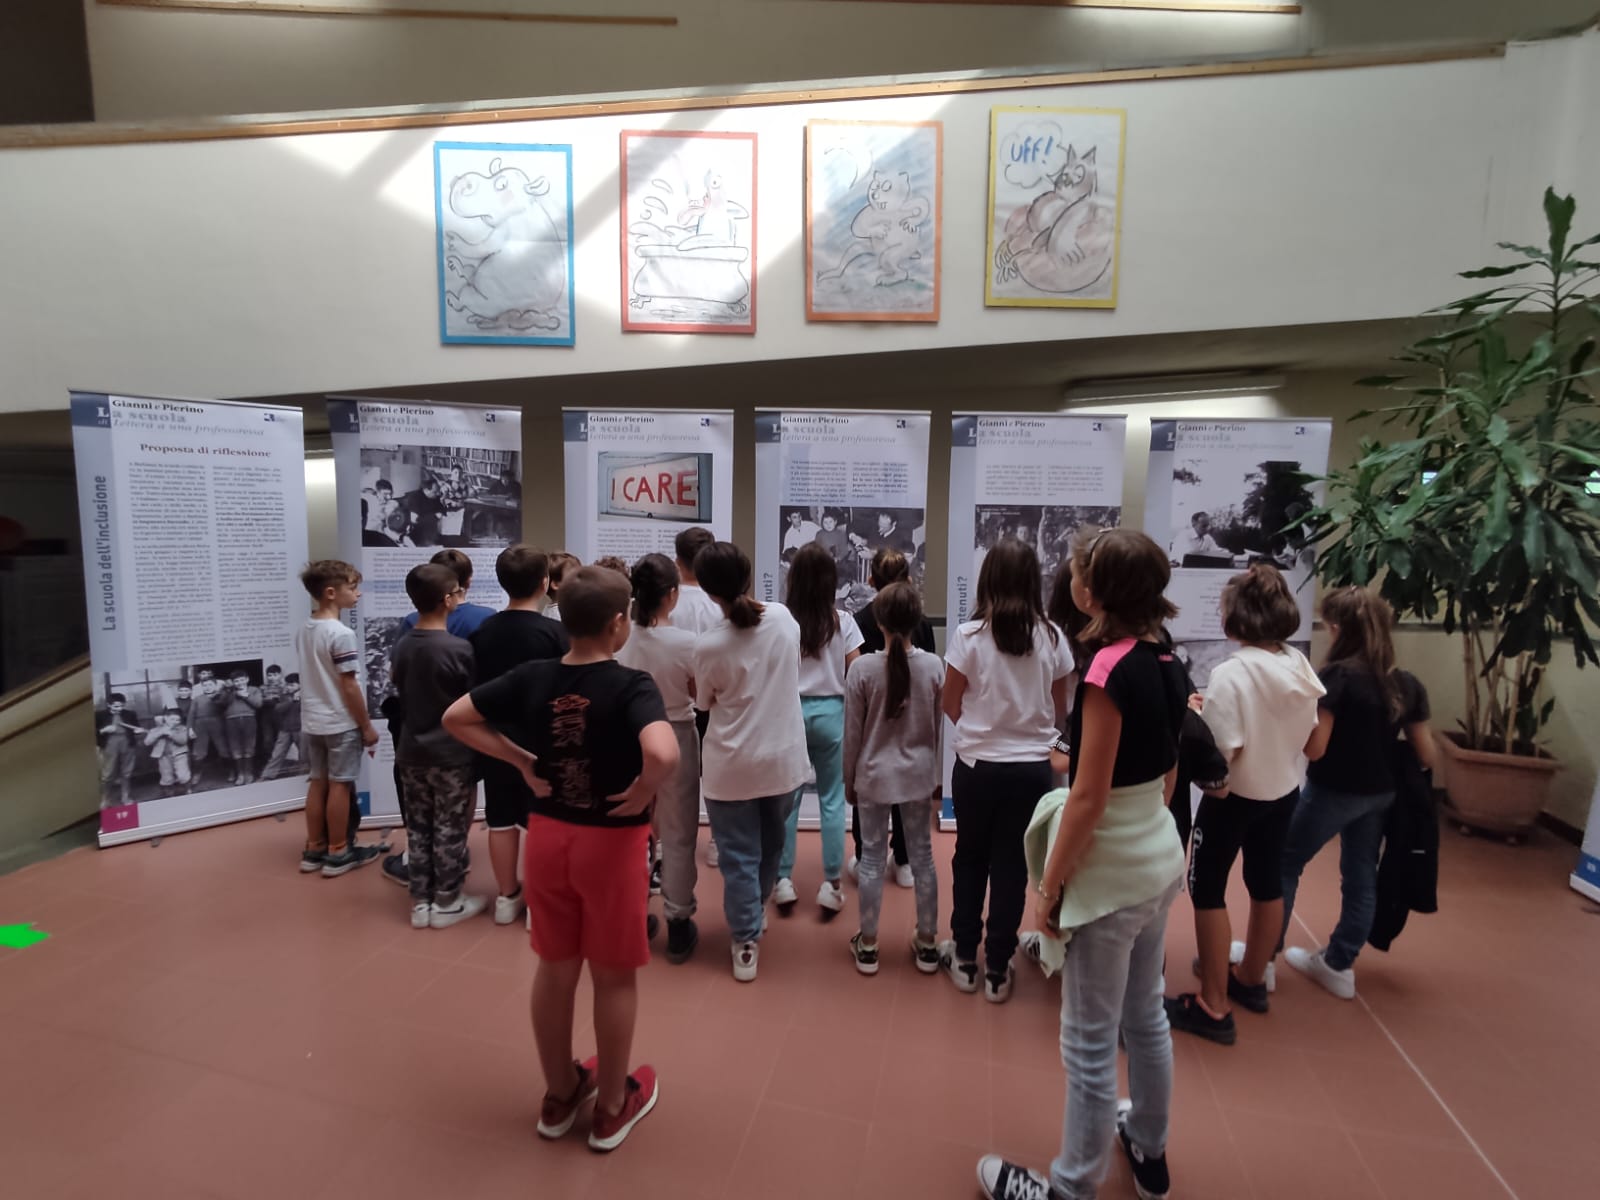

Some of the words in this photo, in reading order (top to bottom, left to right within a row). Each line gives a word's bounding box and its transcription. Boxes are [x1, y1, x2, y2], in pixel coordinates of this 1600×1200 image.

[112, 400, 152, 410] Gianni
[163, 403, 204, 414] Pierino
[360, 405, 392, 414] Gianni
[400, 407, 434, 416] Pierino
[128, 411, 186, 423] scuola
[374, 415, 419, 426] scuola
[782, 416, 812, 424] Gianni
[818, 416, 849, 424] Pierino
[113, 419, 153, 429] Lettera
[600, 424, 641, 433] scuola
[793, 425, 836, 434] scuola
[1015, 420, 1045, 428] Pierino
[1178, 424, 1207, 432] Gianni
[1214, 424, 1246, 432] Pierino
[991, 428, 1031, 438] scuola
[1188, 432, 1231, 442] scuola
[139, 443, 195, 455] Proposta
[197, 446, 208, 454] di
[213, 447, 271, 457] riflessione
[611, 478, 615, 501] I
[623, 470, 697, 507] CARE
[93, 475, 112, 570] dell'inclusione
[100, 572, 115, 614] scuola
[102, 616, 116, 631] La
